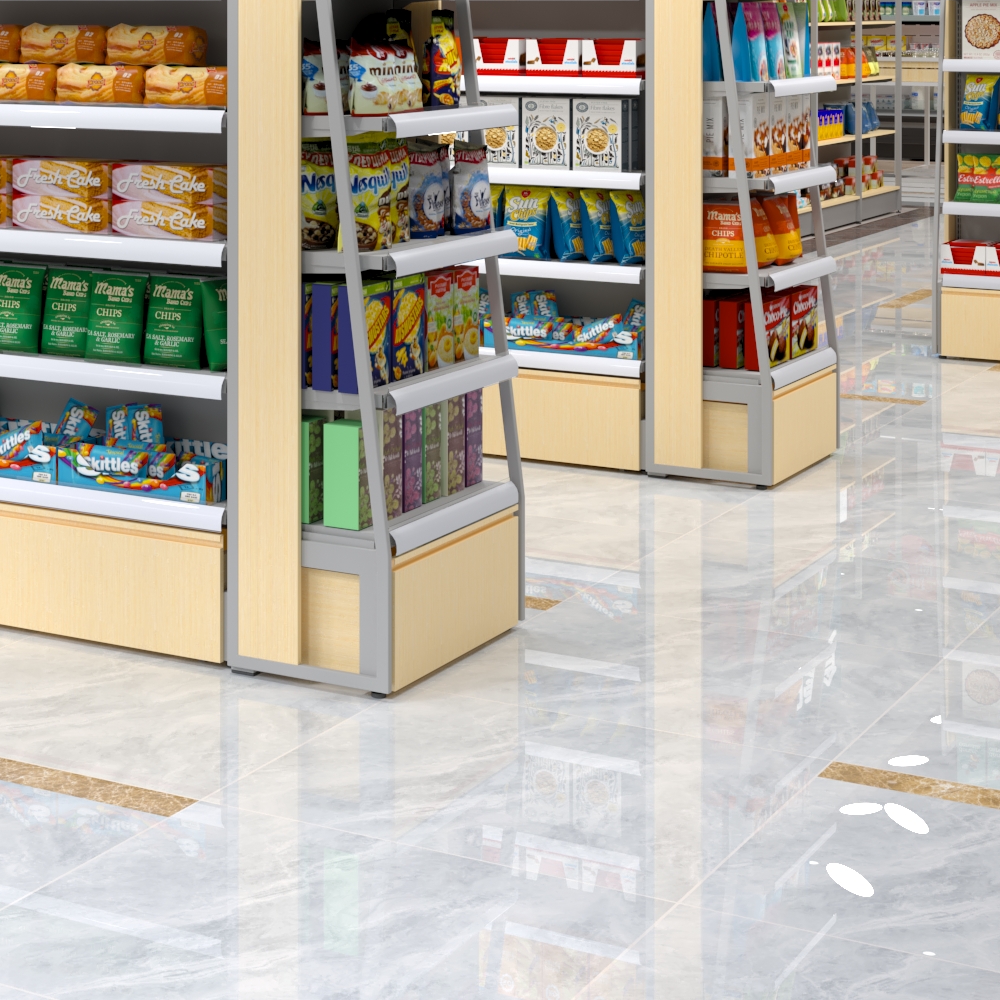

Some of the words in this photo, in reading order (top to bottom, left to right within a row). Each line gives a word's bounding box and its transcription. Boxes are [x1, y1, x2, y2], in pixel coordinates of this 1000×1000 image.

[116, 173, 165, 193] Fresh
[168, 175, 206, 196] Cake
[350, 170, 390, 194] Nesqui
[508, 197, 538, 212] Sun
[17, 204, 63, 223] Fresh
[65, 205, 101, 224] Cake
[116, 209, 165, 229] Fresh
[168, 212, 206, 231] Cake
[510, 208, 537, 221] Chips
[704, 251, 744, 259] CHIPOTLE
[50, 277, 89, 292] Mama's
[95, 281, 134, 297] Mama's
[153, 284, 193, 300] Mama's
[52, 302, 77, 312] CHIPS
[96, 308, 122, 318] CHIPS
[155, 311, 181, 321] CHIPS
[577, 320, 614, 342] Skittles
